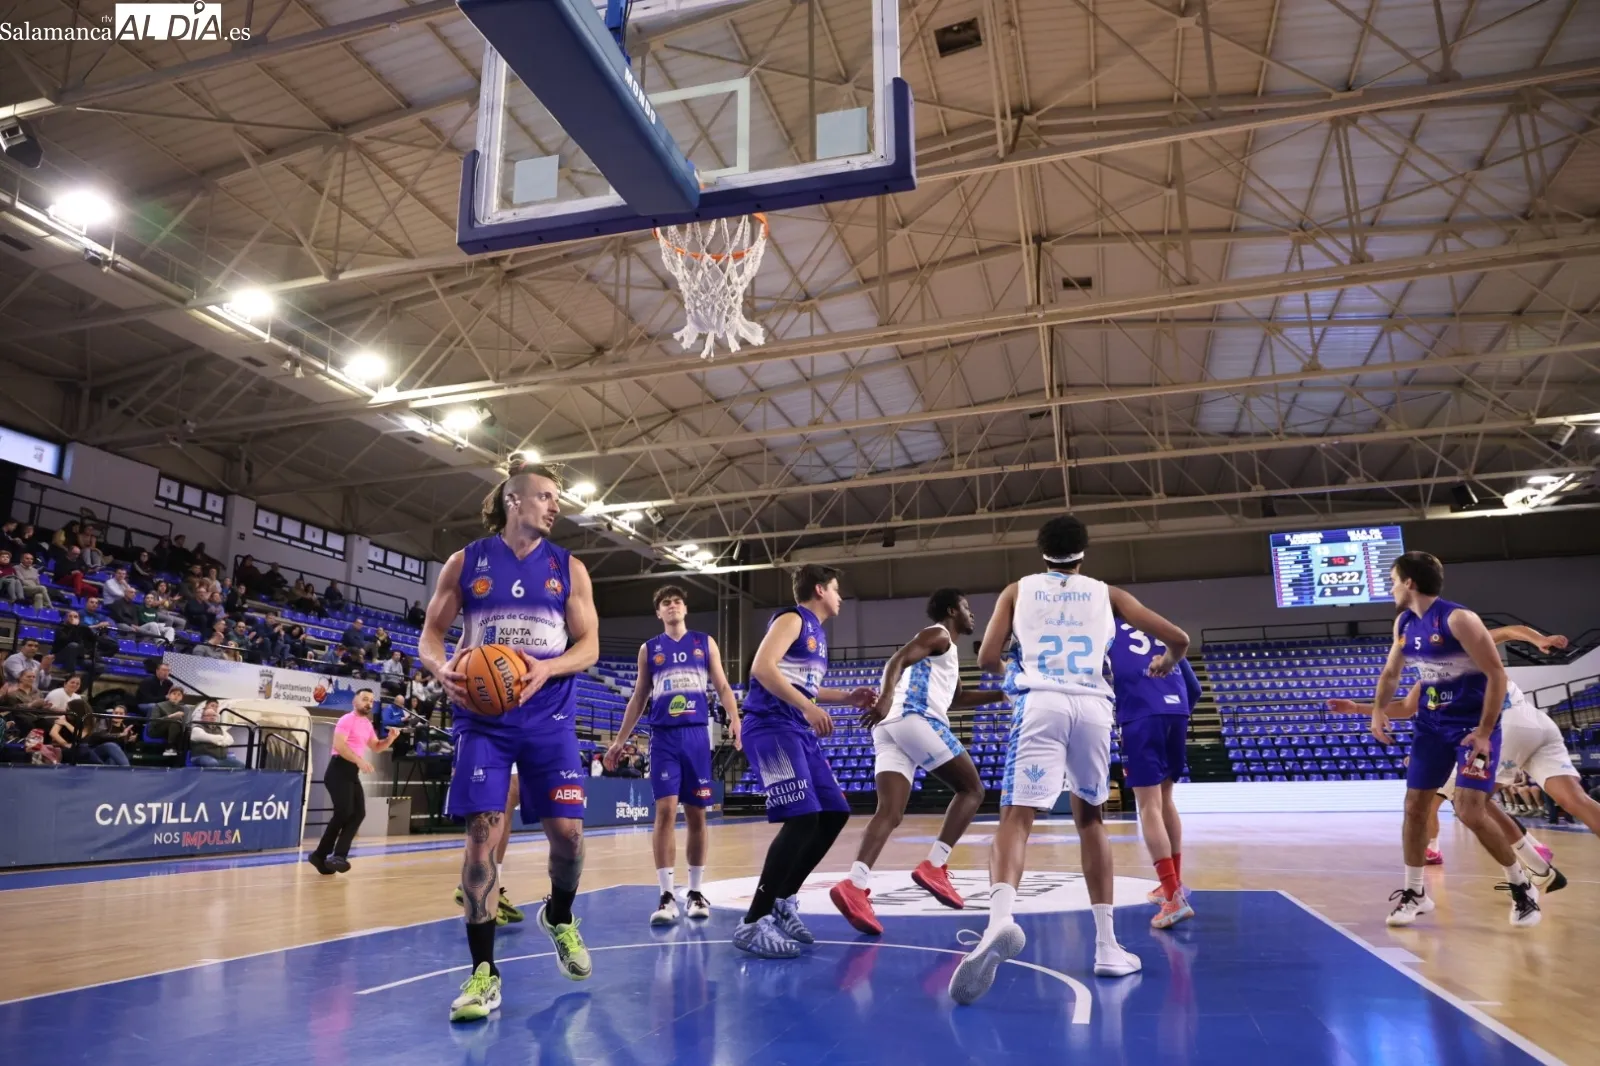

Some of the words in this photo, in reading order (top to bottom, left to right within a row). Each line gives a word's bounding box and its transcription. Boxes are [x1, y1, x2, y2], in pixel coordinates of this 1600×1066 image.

[625, 67, 656, 125] MONDO
[1321, 572, 1359, 585] 03:22
[511, 579, 525, 598] 6
[1324, 588, 1332, 596] 2
[499, 628, 531, 636] XUNTA
[498, 637, 510, 645] DE
[512, 638, 548, 646] GALICIA
[1414, 637, 1421, 650] 5
[673, 652, 687, 663] 10
[1038, 635, 1093, 675] 22
[494, 656, 515, 703] Wilson
[275, 682, 312, 693] Ayuntamiento
[282, 692, 311, 702] Salamanca
[798, 779, 808, 789] DE
[95, 801, 209, 826] CASTILLA
[220, 801, 235, 826] Y
[240, 794, 290, 821] LEÓN
[154, 832, 180, 844] NOS
[182, 829, 241, 849] IMPULSA
